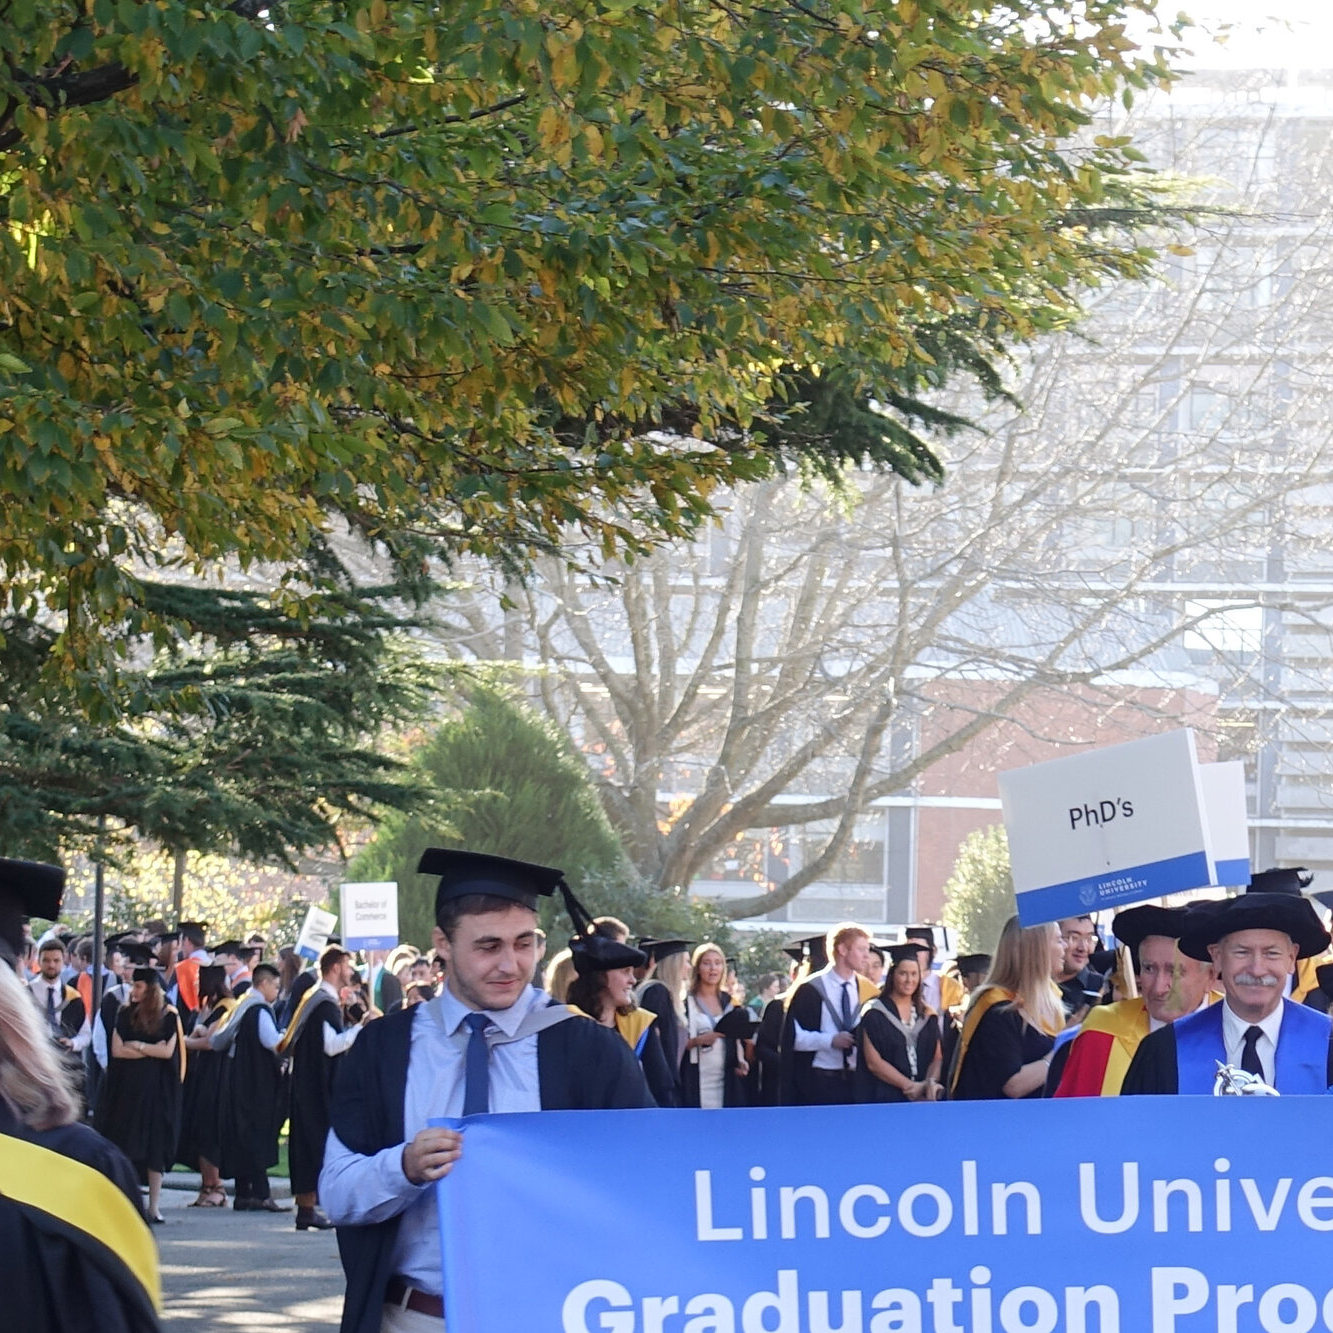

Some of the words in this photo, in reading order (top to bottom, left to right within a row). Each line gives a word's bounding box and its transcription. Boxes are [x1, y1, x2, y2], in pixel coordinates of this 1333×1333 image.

[1069, 797, 1134, 830] PhD's
[1098, 877, 1133, 890] LINCOLN
[1099, 880, 1147, 896] UNIVERSITY
[695, 1160, 1042, 1241] Lincoln
